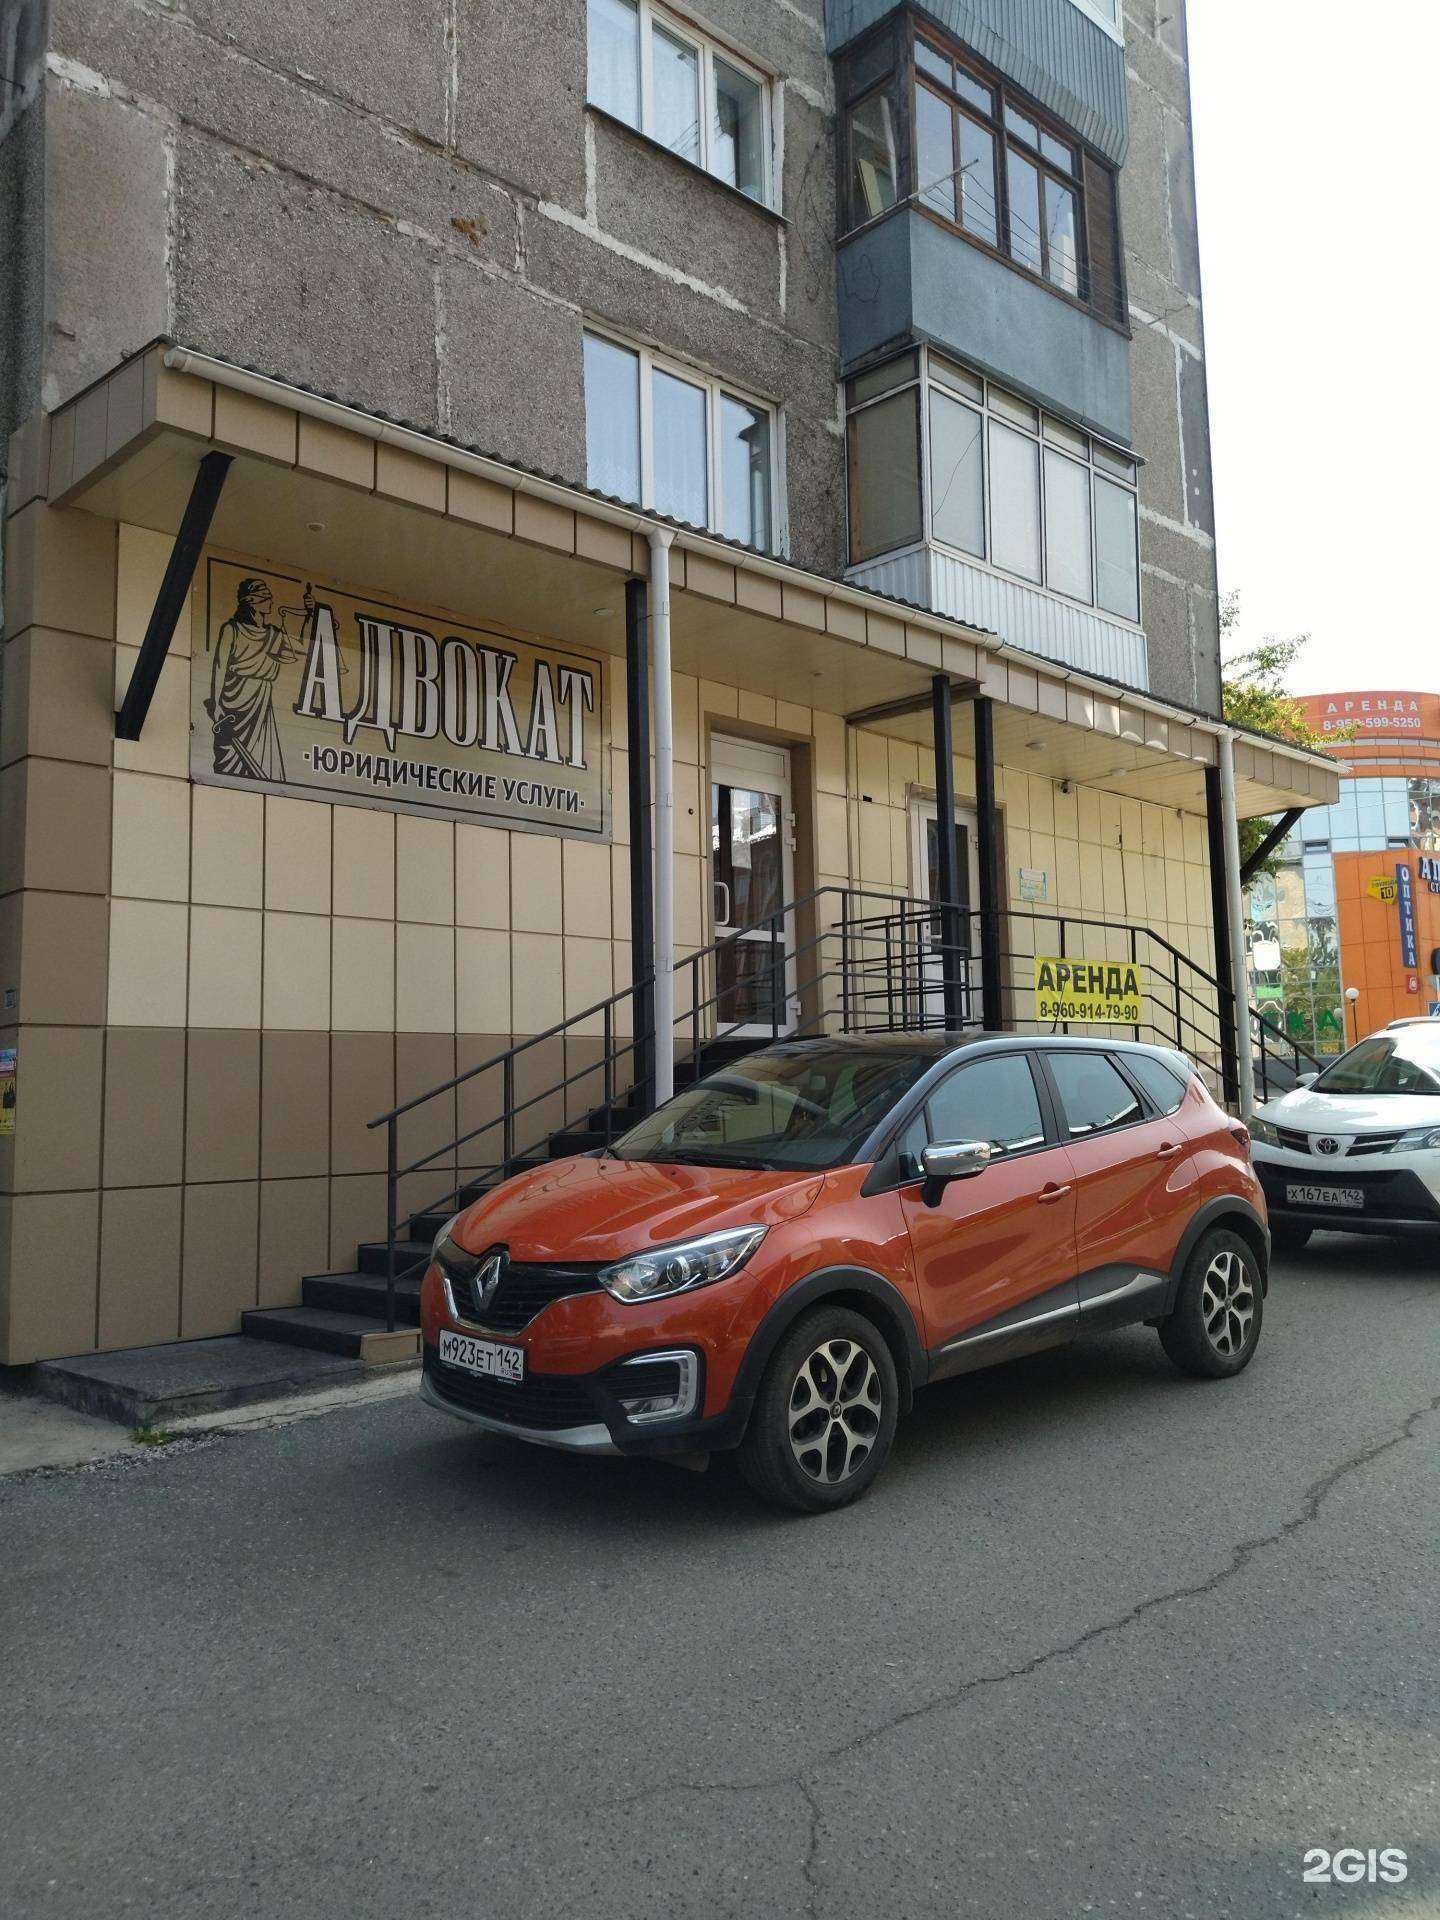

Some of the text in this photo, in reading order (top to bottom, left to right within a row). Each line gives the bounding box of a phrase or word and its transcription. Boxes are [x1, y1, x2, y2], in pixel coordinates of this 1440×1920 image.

[295, 602, 594, 770] АДВОКАТ
[1327, 700, 1418, 713] АРЕНДА
[312, 745, 579, 813] ЮРИДИЧЕСКИЕ УСЛУГИ
[1401, 867, 1415, 968] ОПТИКА
[1037, 960, 1139, 1000] АРЕНДА
[1040, 1001, 1138, 1020] 8-960-914-79-90
[1341, 1190, 1360, 1200] 142
[443, 1337, 520, 1371] М923ЕТ 142
